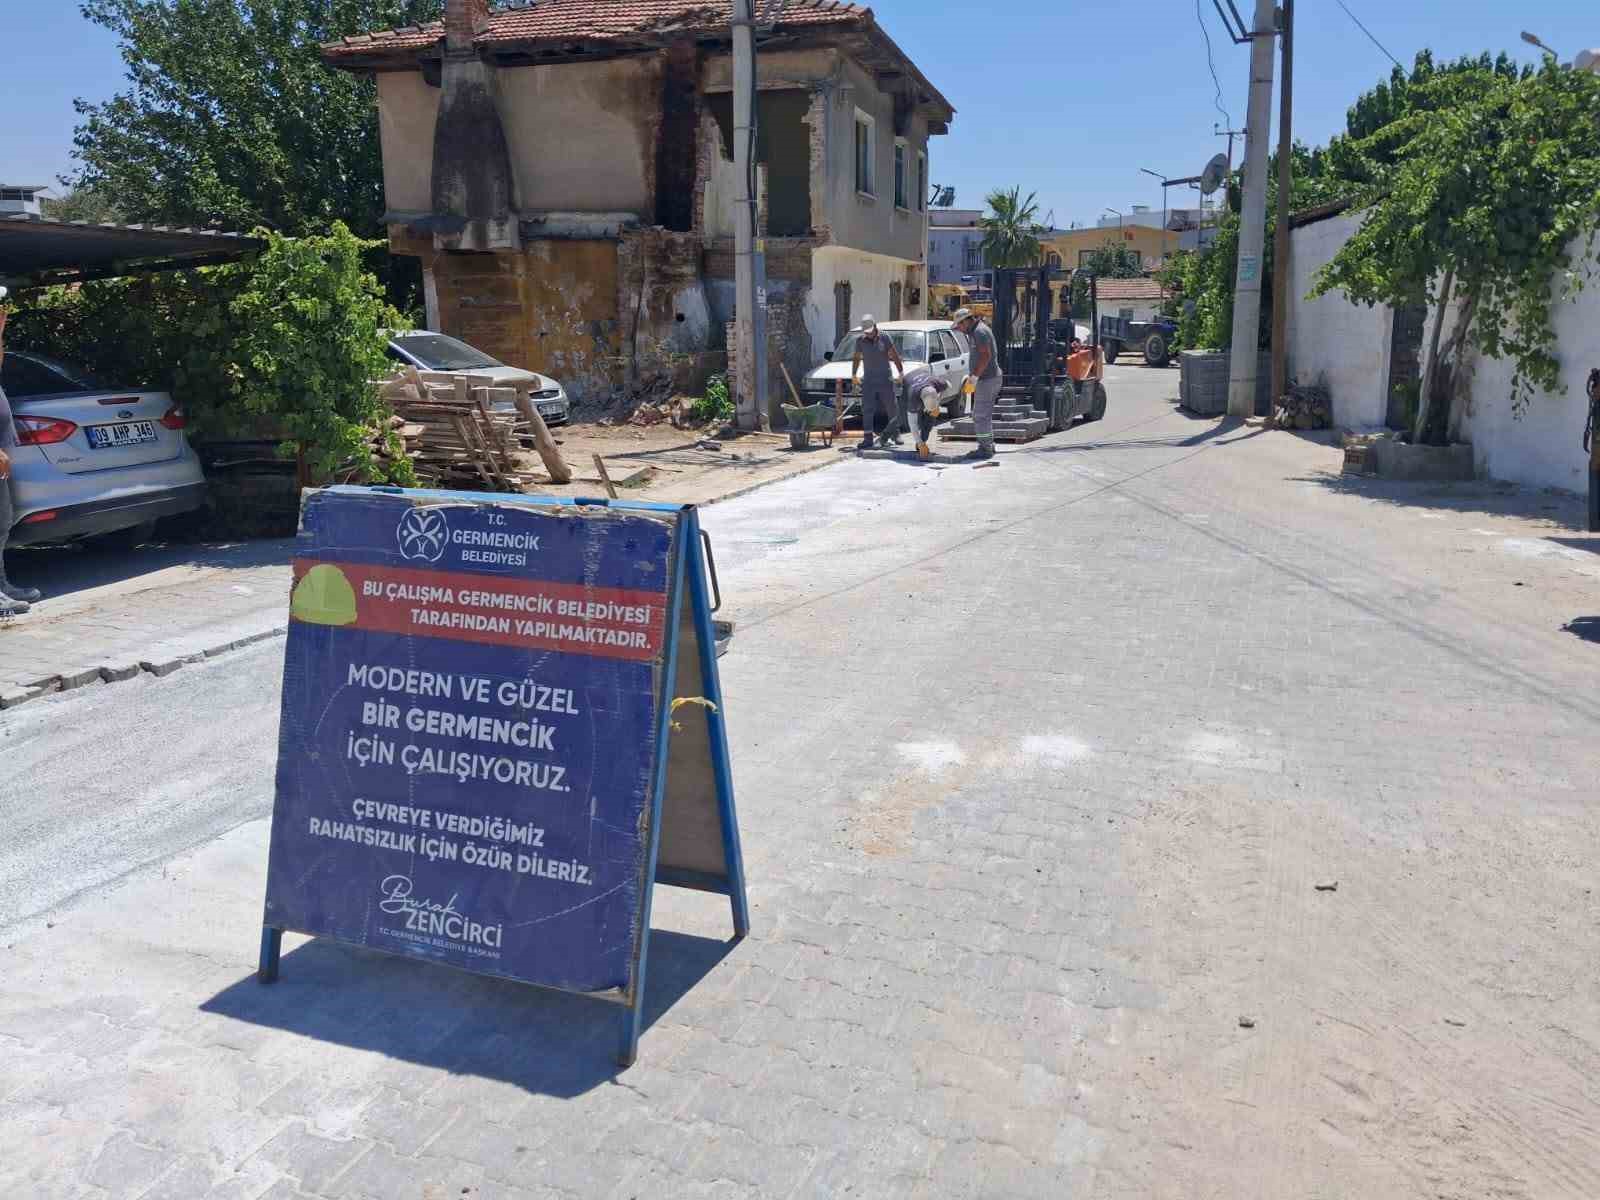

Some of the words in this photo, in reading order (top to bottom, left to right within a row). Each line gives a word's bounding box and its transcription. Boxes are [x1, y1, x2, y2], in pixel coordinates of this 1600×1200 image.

[96, 428, 109, 442] 09
[113, 425, 129, 440] AHP
[452, 529, 540, 551] GERMENCİK
[487, 513, 507, 526] T.C.
[461, 549, 527, 567] BELEDİYESİ
[362, 580, 383, 597] BU
[386, 583, 454, 606] ÇALIŞMA
[458, 589, 553, 614] GERMENCİK
[556, 598, 651, 625] BELEDİYESİ
[411, 608, 510, 634] TARAFINDAN
[514, 620, 652, 649] YAPILMAKTADIR.
[347, 663, 453, 698] MODERN
[460, 677, 491, 702] VE
[498, 678, 579, 715] GÜZEL
[362, 698, 400, 728] BİR
[406, 706, 556, 751] GERMENCİK
[347, 730, 394, 766] İÇİN
[401, 745, 571, 793] ÇALIŞIYORUZ.
[352, 798, 431, 828] ÇEVREYE
[435, 808, 545, 848] VERDİĞİMİZ
[309, 817, 416, 853] RAHATSIZLIK
[420, 830, 457, 862] İÇİN
[462, 836, 512, 872] ÖZÜR
[517, 851, 593, 886] DİLERİZ.
[379, 875, 464, 918] Burak
[405, 908, 503, 948] ZENCİRCİ
